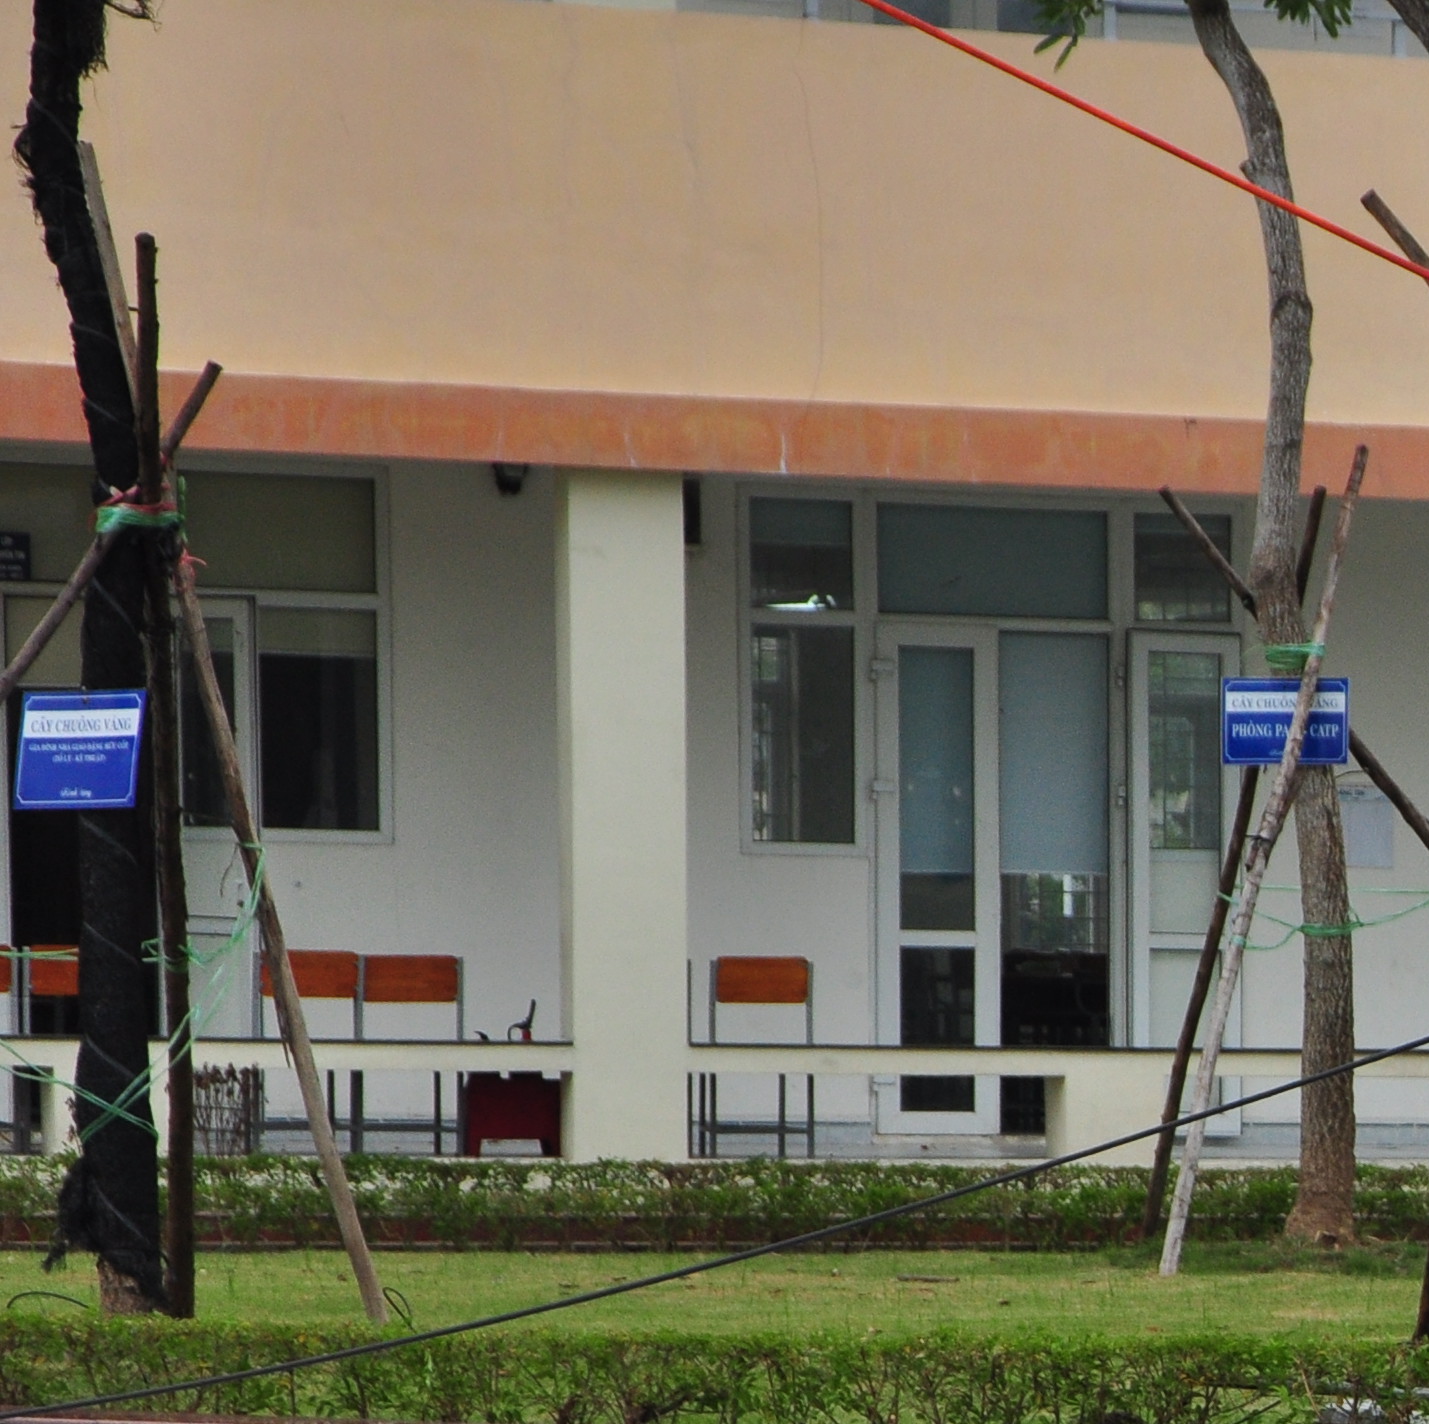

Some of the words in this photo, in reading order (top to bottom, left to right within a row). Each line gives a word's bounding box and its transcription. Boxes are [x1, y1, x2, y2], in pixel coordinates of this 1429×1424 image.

[1232, 695, 1255, 708] CÂY
[1257, 695, 1297, 708] CHUÔN
[31, 716, 52, 733] CÂY
[55, 715, 102, 733] CHUÔNG
[104, 715, 131, 731] VÀNG
[1232, 720, 1272, 737] PHÒNG
[1275, 723, 1290, 737] PA
[1309, 723, 1339, 737] CATP
